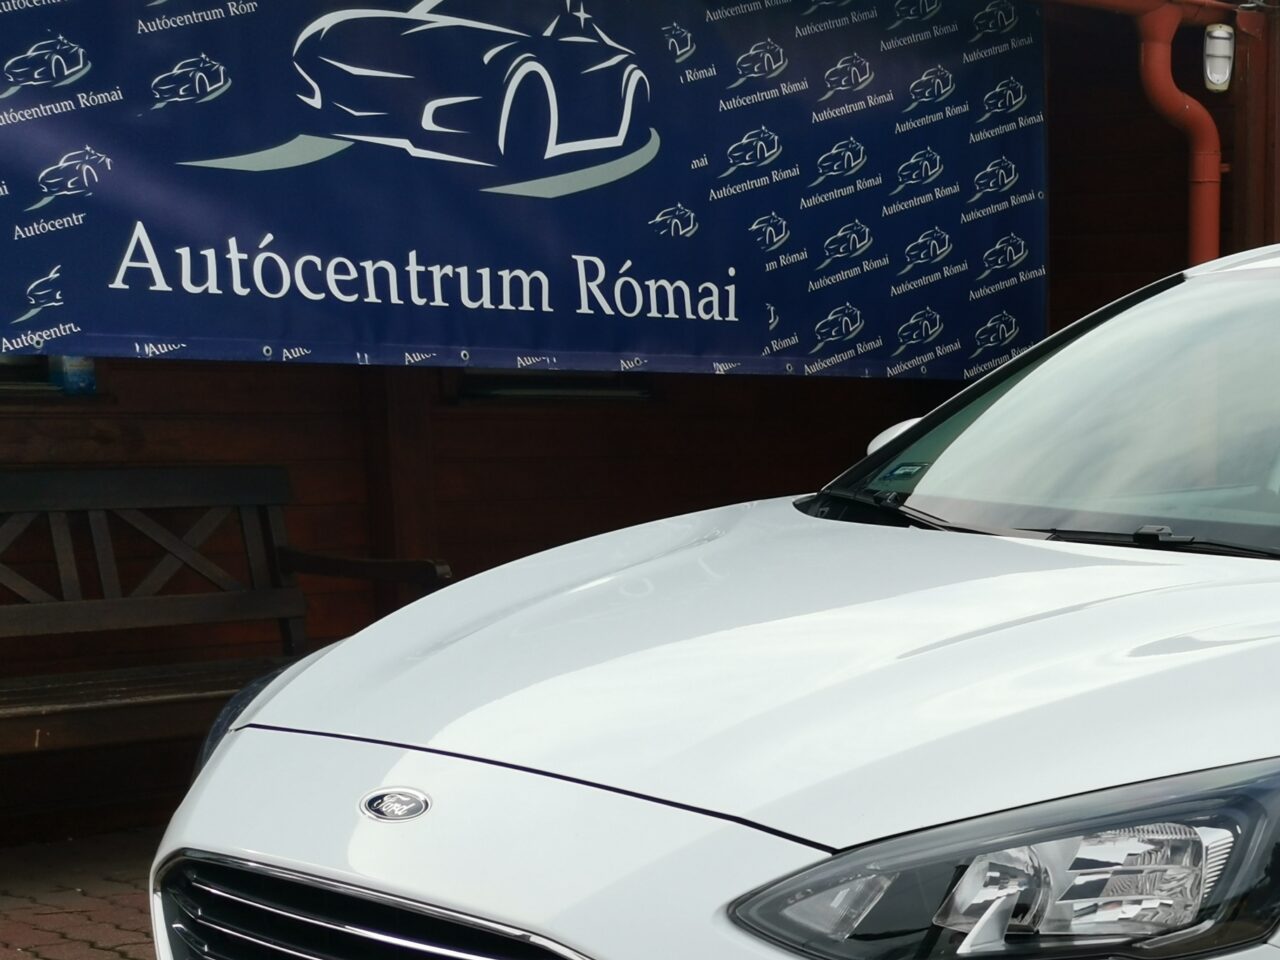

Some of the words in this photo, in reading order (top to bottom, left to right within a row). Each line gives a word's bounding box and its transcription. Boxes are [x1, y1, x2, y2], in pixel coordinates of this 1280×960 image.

[136, 7, 225, 34] Autócentrum
[685, 64, 717, 82] Római
[77, 86, 123, 108] Római
[779, 248, 808, 267] Római
[108, 221, 554, 312] Autócentrum
[571, 254, 739, 321] Római
